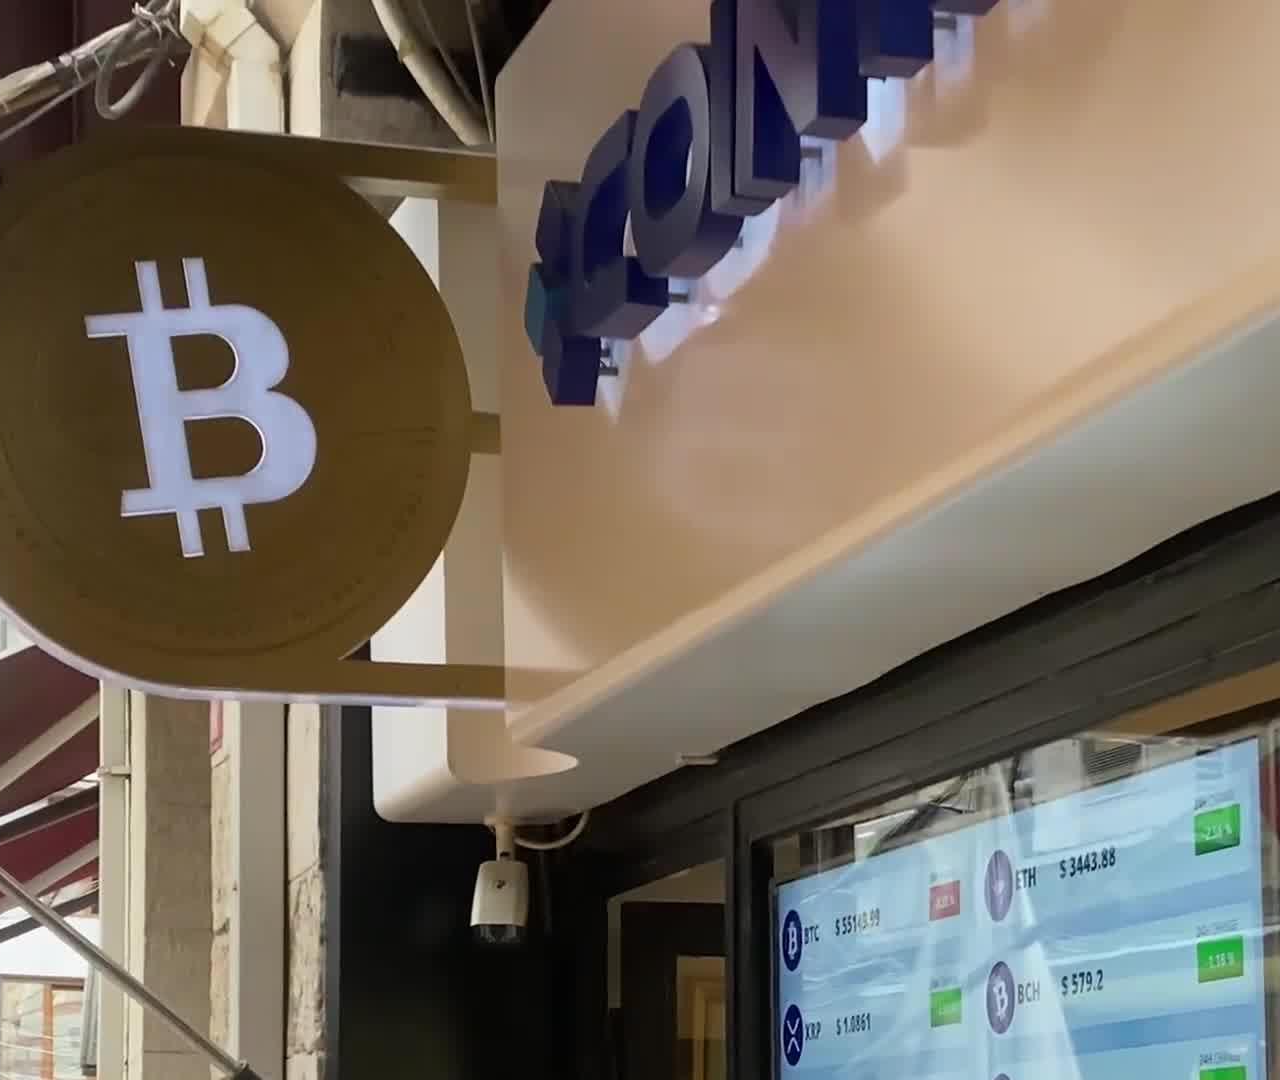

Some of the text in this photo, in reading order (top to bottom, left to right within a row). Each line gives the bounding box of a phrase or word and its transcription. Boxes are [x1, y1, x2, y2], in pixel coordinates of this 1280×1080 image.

[1015, 867, 1037, 890] ETH
[1069, 847, 1116, 878] 3443.88
[1017, 982, 1040, 1004] BCH
[1071, 969, 1104, 995] 579.2
